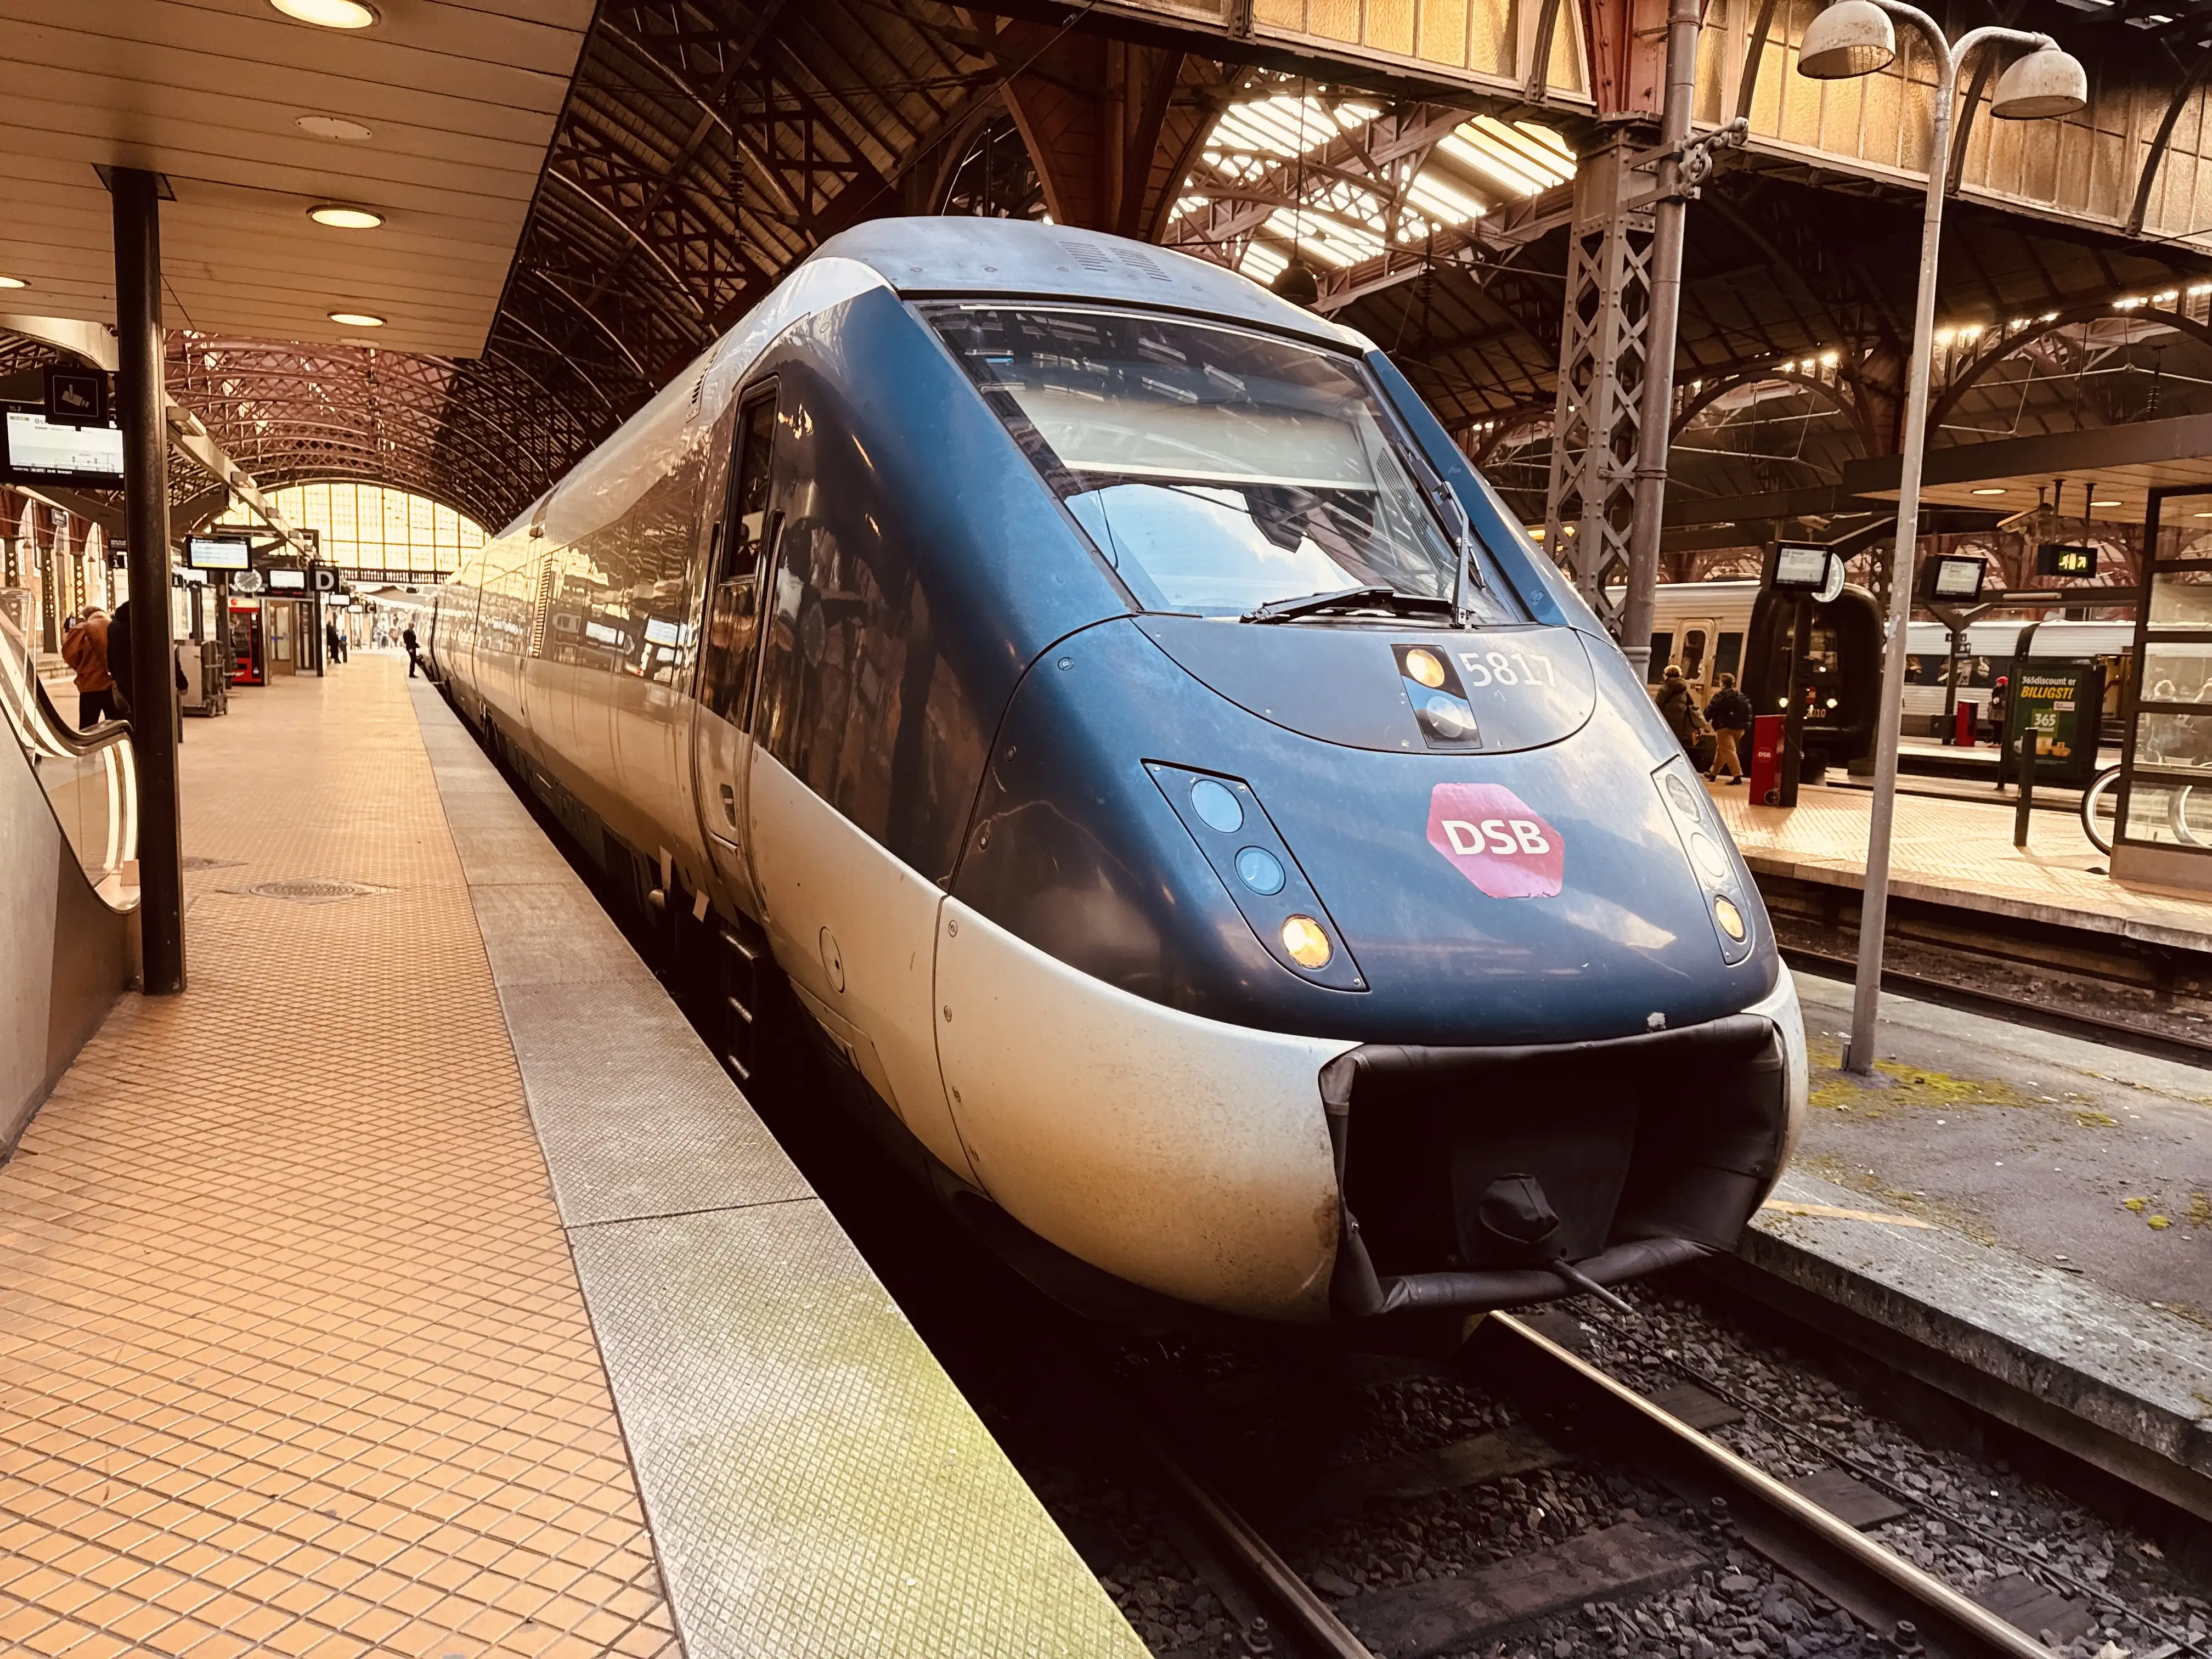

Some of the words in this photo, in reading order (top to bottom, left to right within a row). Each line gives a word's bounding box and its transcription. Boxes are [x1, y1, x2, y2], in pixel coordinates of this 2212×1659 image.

[315, 571, 334, 590] D
[367, 605, 375, 613] C
[1458, 652, 1556, 687] 5817
[2022, 676, 2067, 685] 365discount
[2021, 686, 2074, 699] BILLIGST!
[2034, 713, 2056, 726] 365
[1441, 820, 1550, 855] DSB
